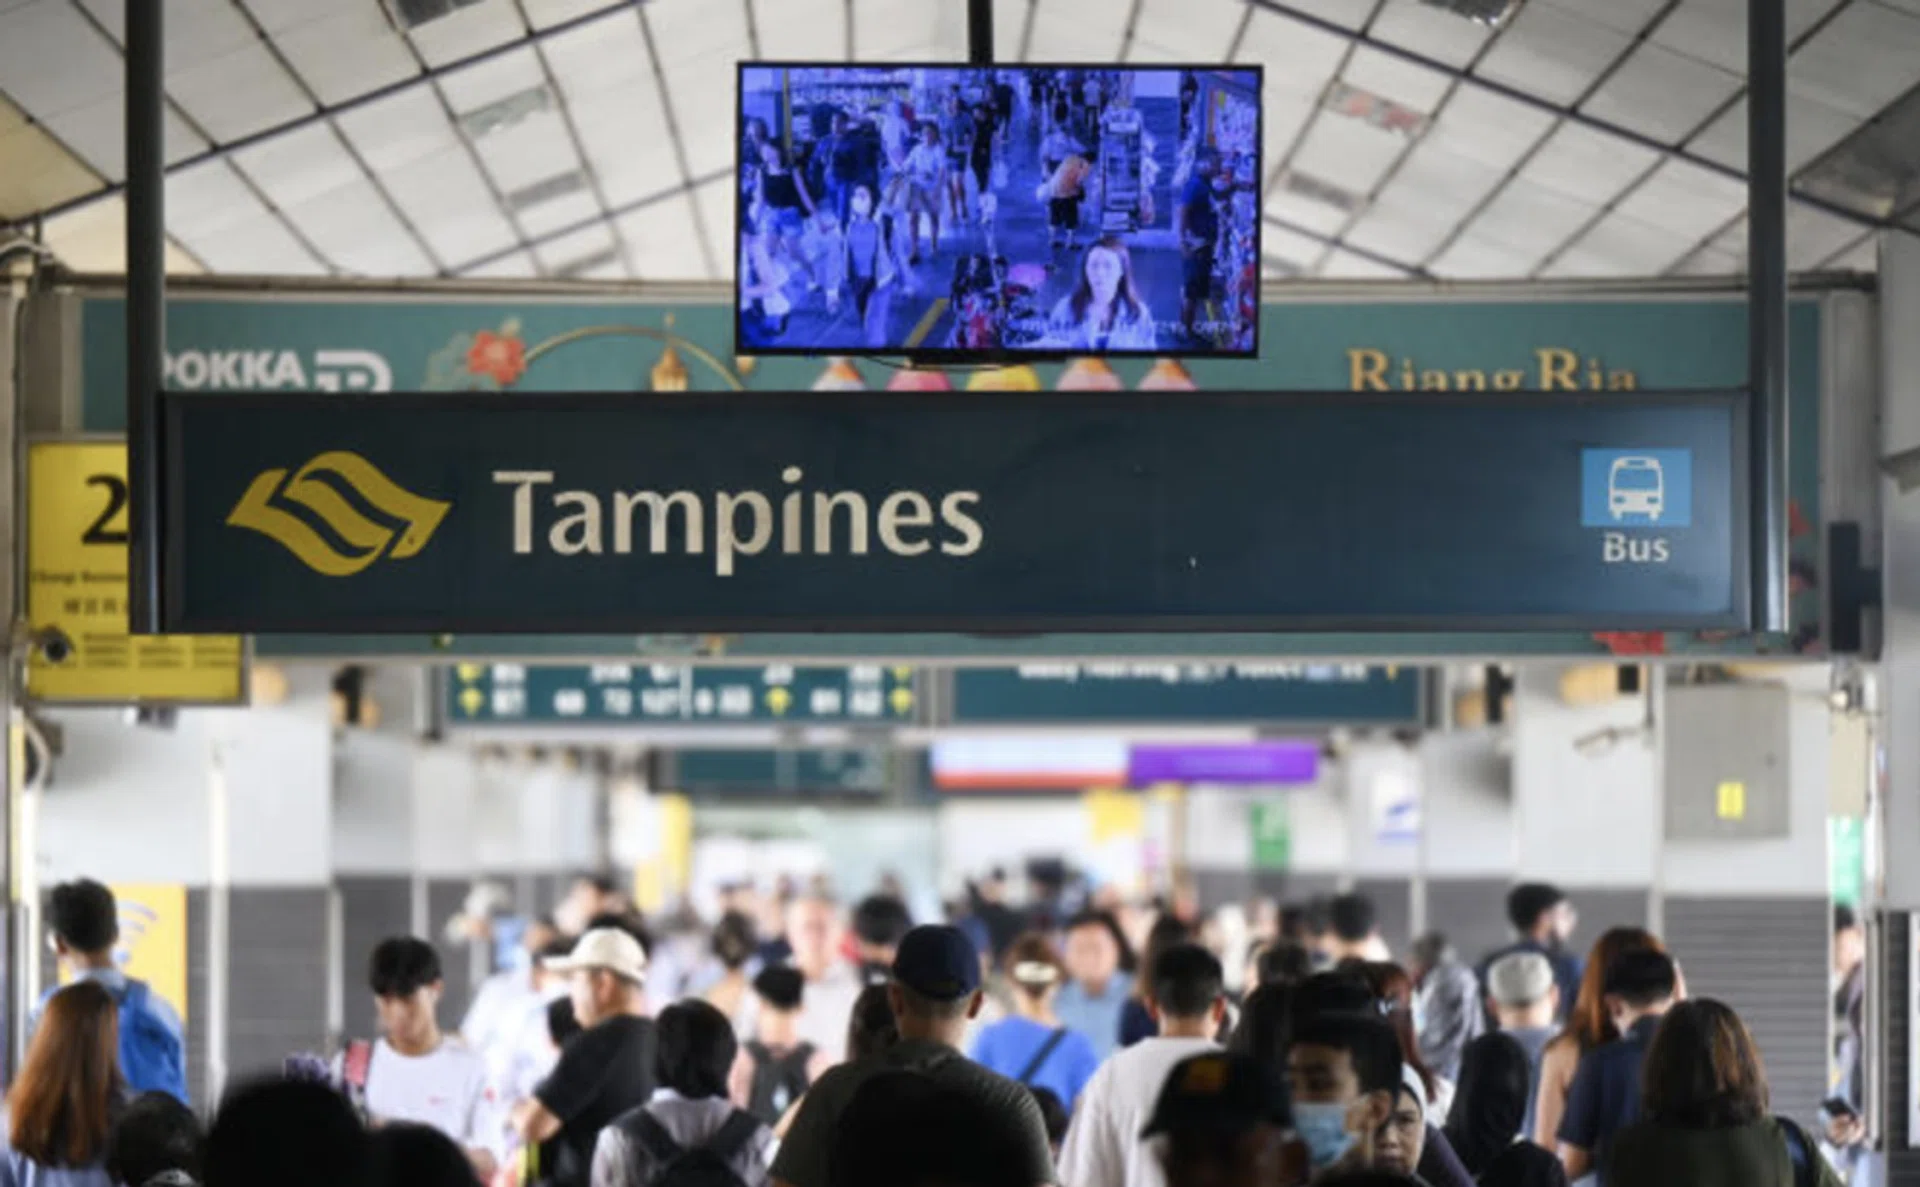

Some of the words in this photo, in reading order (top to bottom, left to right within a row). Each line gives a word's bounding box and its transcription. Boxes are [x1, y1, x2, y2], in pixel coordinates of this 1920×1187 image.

[1536, 348, 1637, 391] Ria
[493, 466, 983, 576] Tampines
[1603, 533, 1670, 562] Bus
